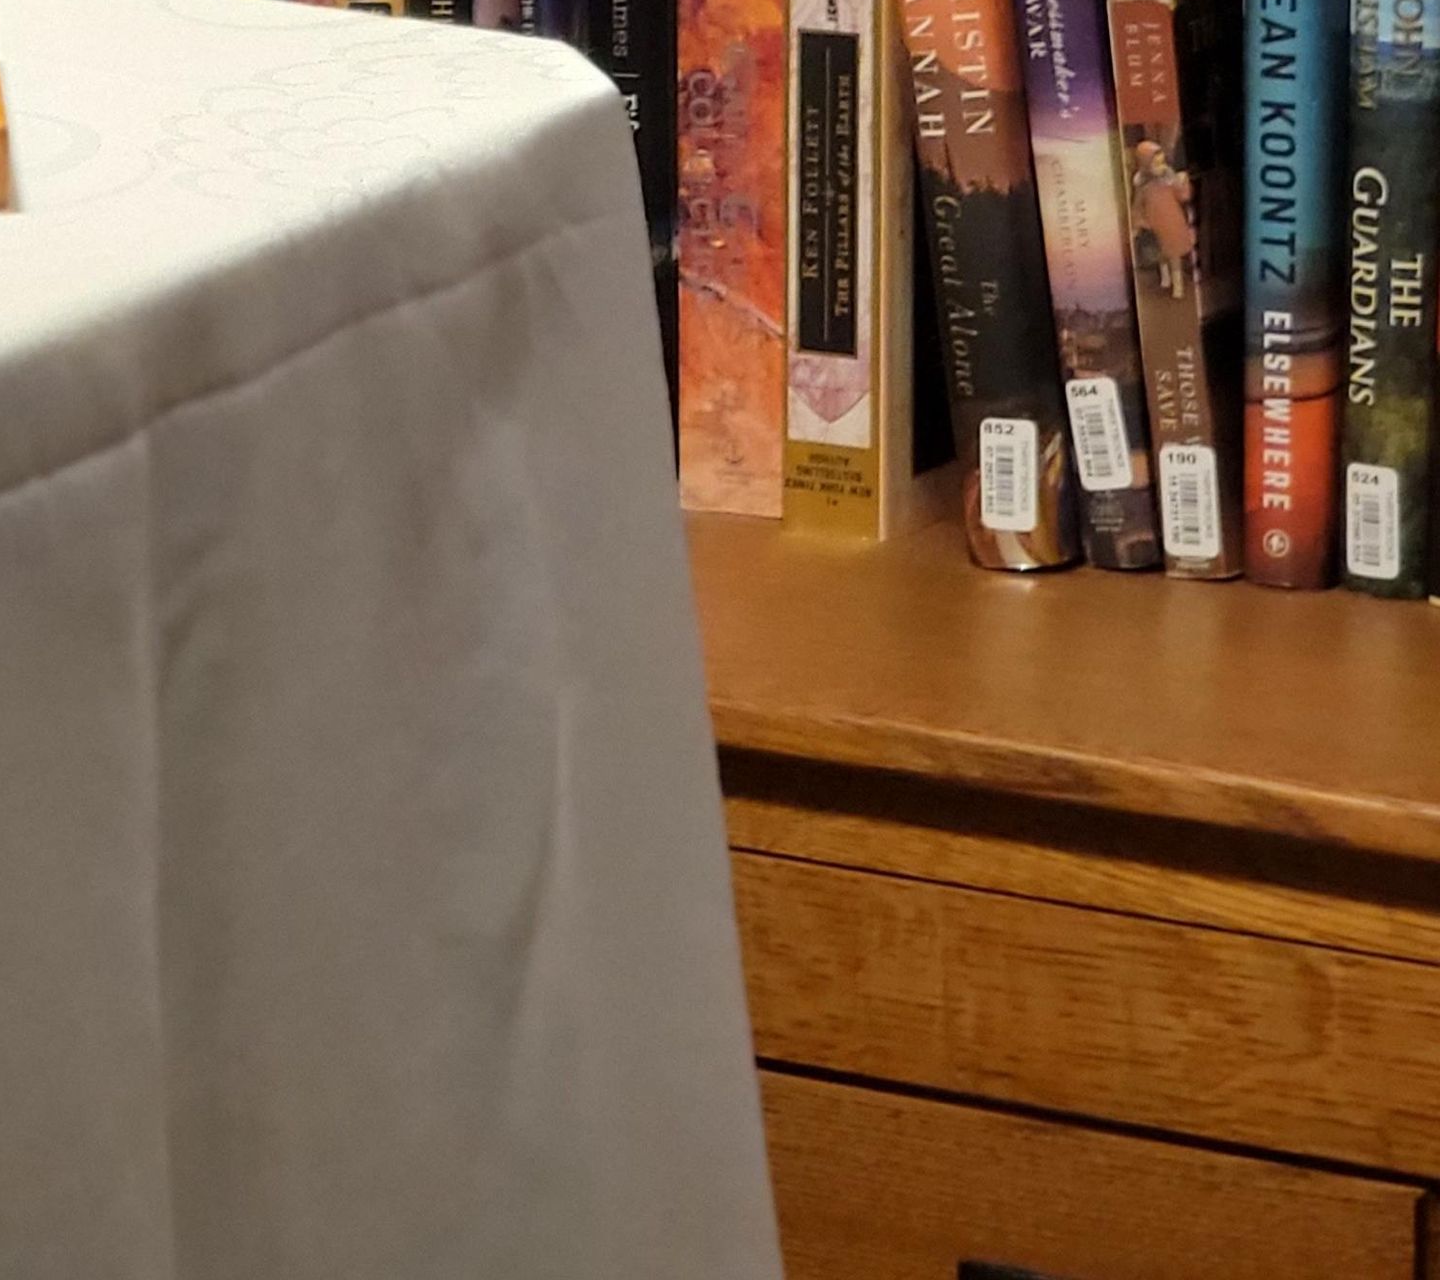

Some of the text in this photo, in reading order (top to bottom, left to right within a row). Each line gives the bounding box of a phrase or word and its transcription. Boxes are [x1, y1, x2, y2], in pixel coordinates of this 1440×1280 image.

[1124, 22, 1144, 91] BLUM
[799, 107, 821, 279] KEN FOLLETT
[834, 73, 855, 272] PILLARS EARTH
[1259, 100, 1298, 287] KOONTZ
[1072, 199, 1091, 249] MARY
[931, 193, 981, 399] Great Alone
[1348, 164, 1391, 408] GUARDIANS
[1388, 249, 1425, 330] THE
[1153, 369, 1178, 432] SAVE
[1174, 346, 1200, 426] THOSE
[1262, 308, 1294, 514] ELSEWHERE
[983, 423, 1016, 436] 852
[1166, 452, 1198, 466] 190
[1351, 473, 1380, 486] 524
